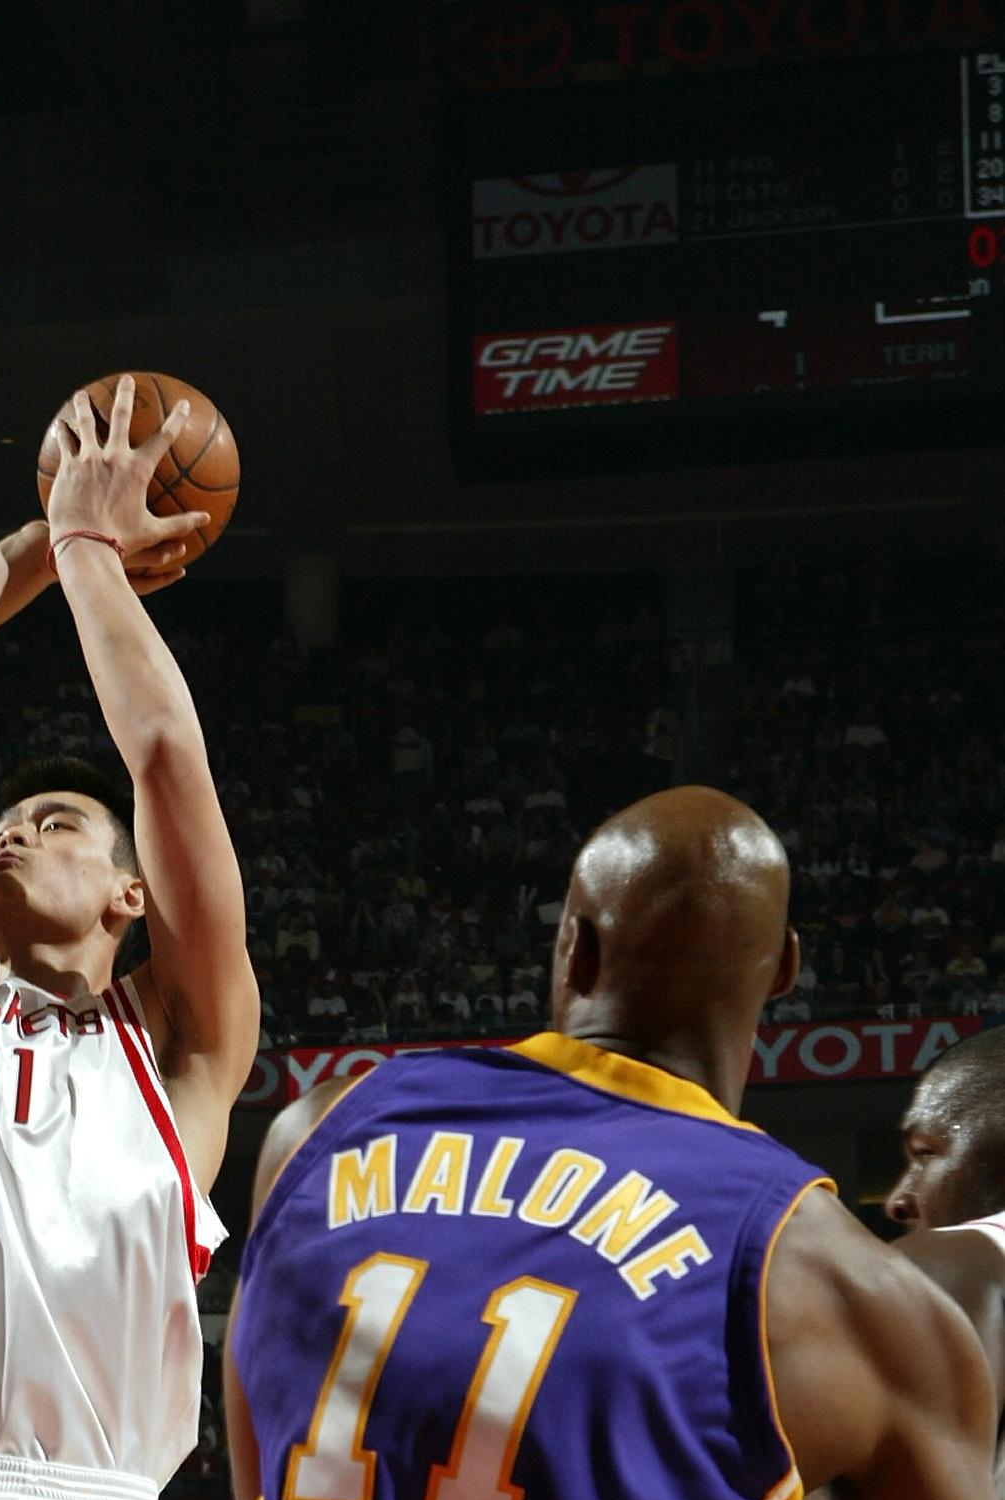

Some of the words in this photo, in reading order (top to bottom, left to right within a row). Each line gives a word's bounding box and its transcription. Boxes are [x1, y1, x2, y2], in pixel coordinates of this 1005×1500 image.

[473, 202, 676, 248] TOYOTA
[479, 326, 672, 367] GAME
[881, 341, 957, 366] TEAM
[496, 360, 646, 399] TIME
[751, 1021, 961, 1078] YOTA
[327, 1130, 714, 1301] MALONE
